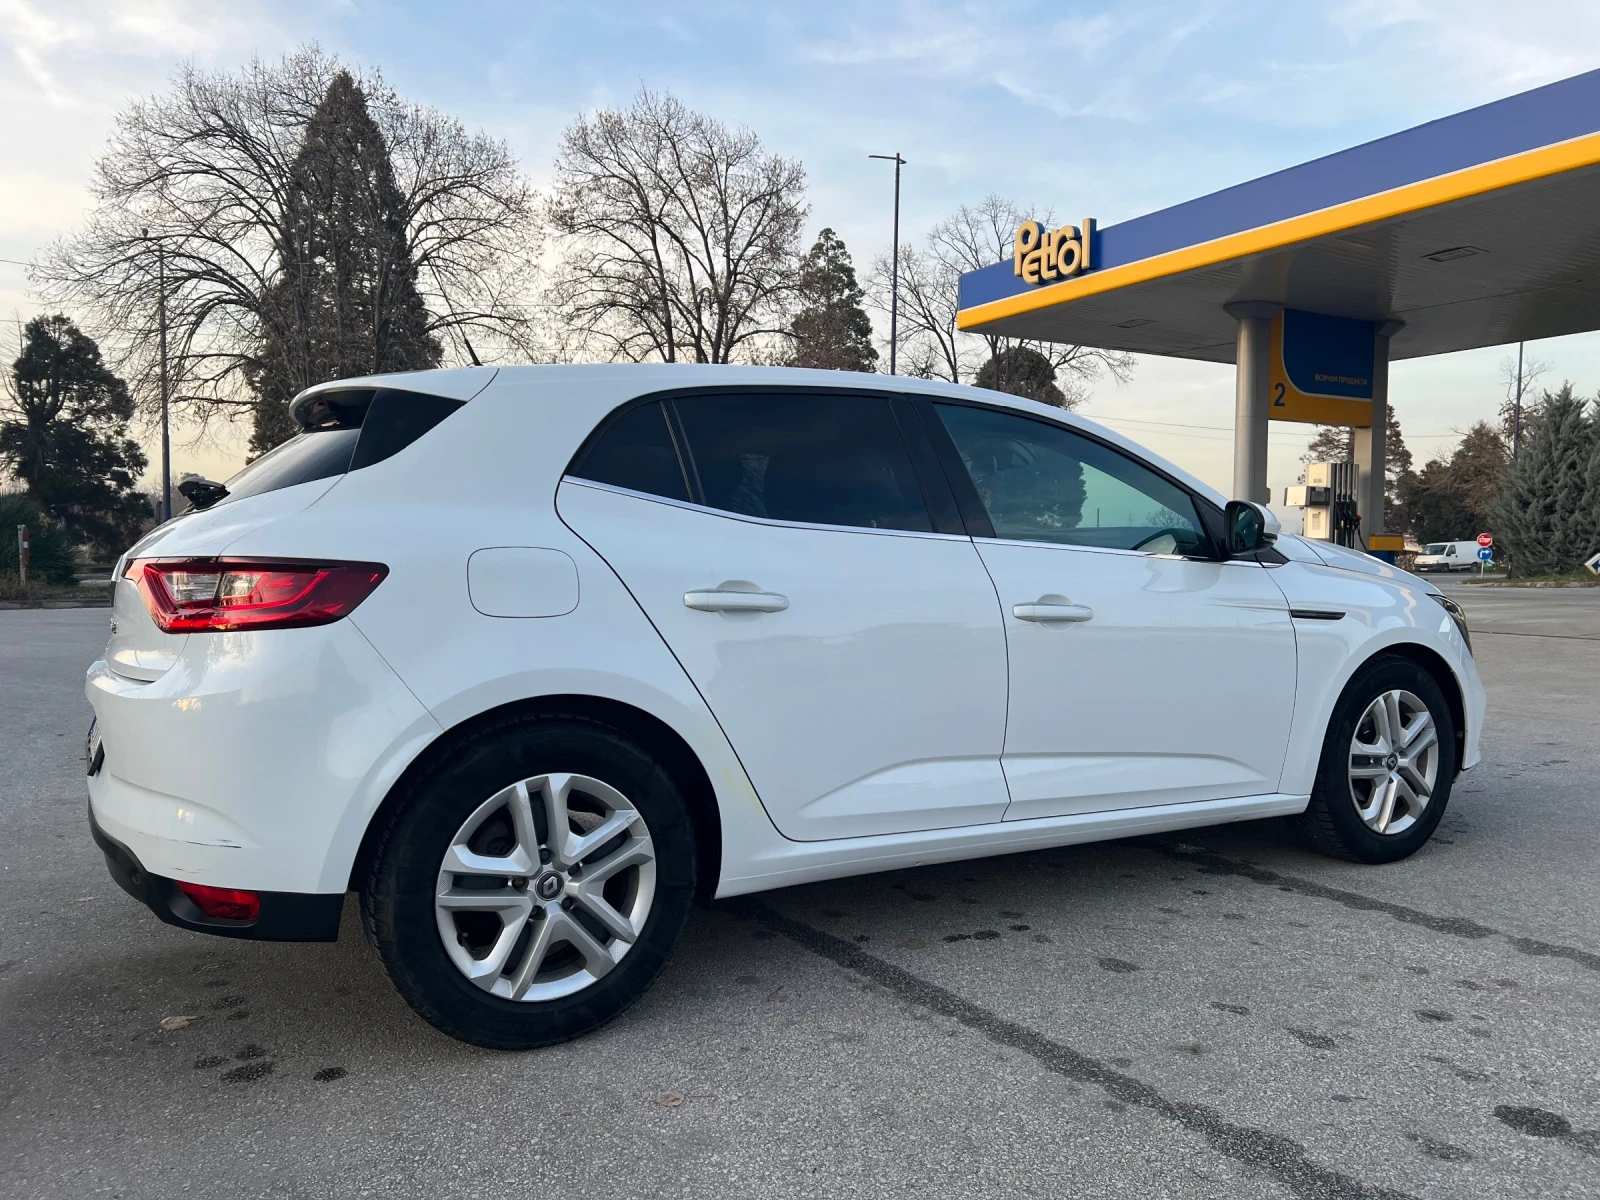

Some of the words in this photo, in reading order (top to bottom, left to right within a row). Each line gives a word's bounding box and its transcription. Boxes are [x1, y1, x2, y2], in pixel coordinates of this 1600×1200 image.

[1314, 373, 1338, 383] ВСИЧКИ
[1338, 376, 1368, 386] ПРОДУКТИ
[1273, 382, 1286, 407] 2
